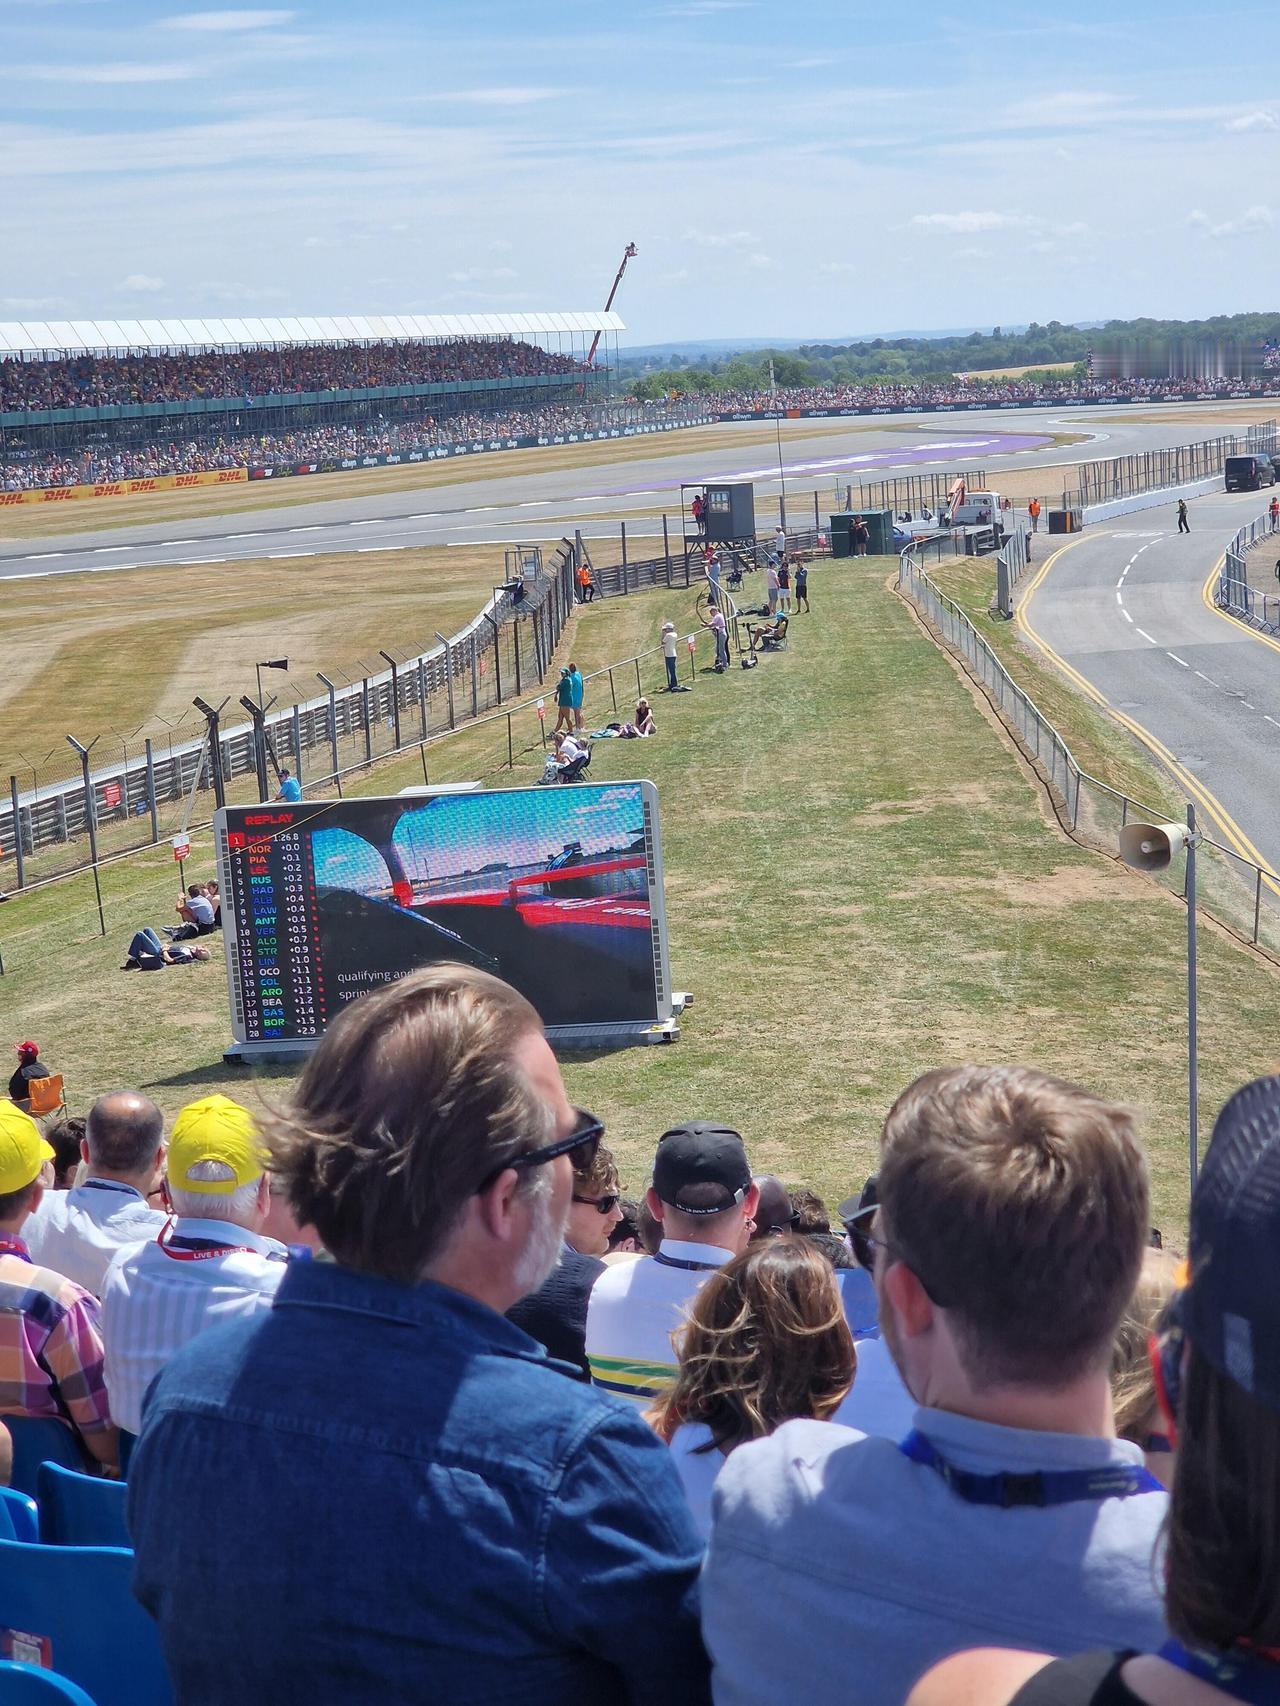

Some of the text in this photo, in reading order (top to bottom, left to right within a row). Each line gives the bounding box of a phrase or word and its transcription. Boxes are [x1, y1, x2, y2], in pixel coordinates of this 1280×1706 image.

[176, 475, 199, 486] DHL
[219, 471, 241, 481] DHL
[94, 485, 121, 496] DHL
[131, 480, 155, 491] DHL
[44, 489, 72, 501] DHL
[245, 813, 293, 825] REPLAY
[235, 837, 239, 845] 1
[274, 833, 299, 842] 1:26.8
[235, 843, 300, 855] 2 NOR +0.0
[249, 856, 266, 864] PIA
[282, 854, 300, 862] +0.1
[283, 864, 301, 872] +0.2
[251, 876, 271, 884] RUS
[254, 907, 277, 915] LAW
[286, 905, 305, 913] +0.4
[255, 917, 277, 925] ANT
[288, 915, 306, 923] +0.4
[288, 925, 307, 933] +0.5
[241, 939, 251, 947] 11
[257, 937, 277, 945] ALO
[290, 946, 309, 954] +0.9
[260, 968, 280, 976] OCO
[292, 966, 310, 974] +1.1
[338, 970, 391, 983] qualifying
[262, 988, 283, 996] ARO
[262, 998, 283, 1006] BEA
[295, 996, 313, 1004] +1.2
[263, 1008, 284, 1016] GAS
[296, 1007, 314, 1015] +1.4
[297, 1017, 315, 1025] +1.5
[298, 1027, 316, 1035] +2.9
[193, 1251, 212, 1259] LIVE
